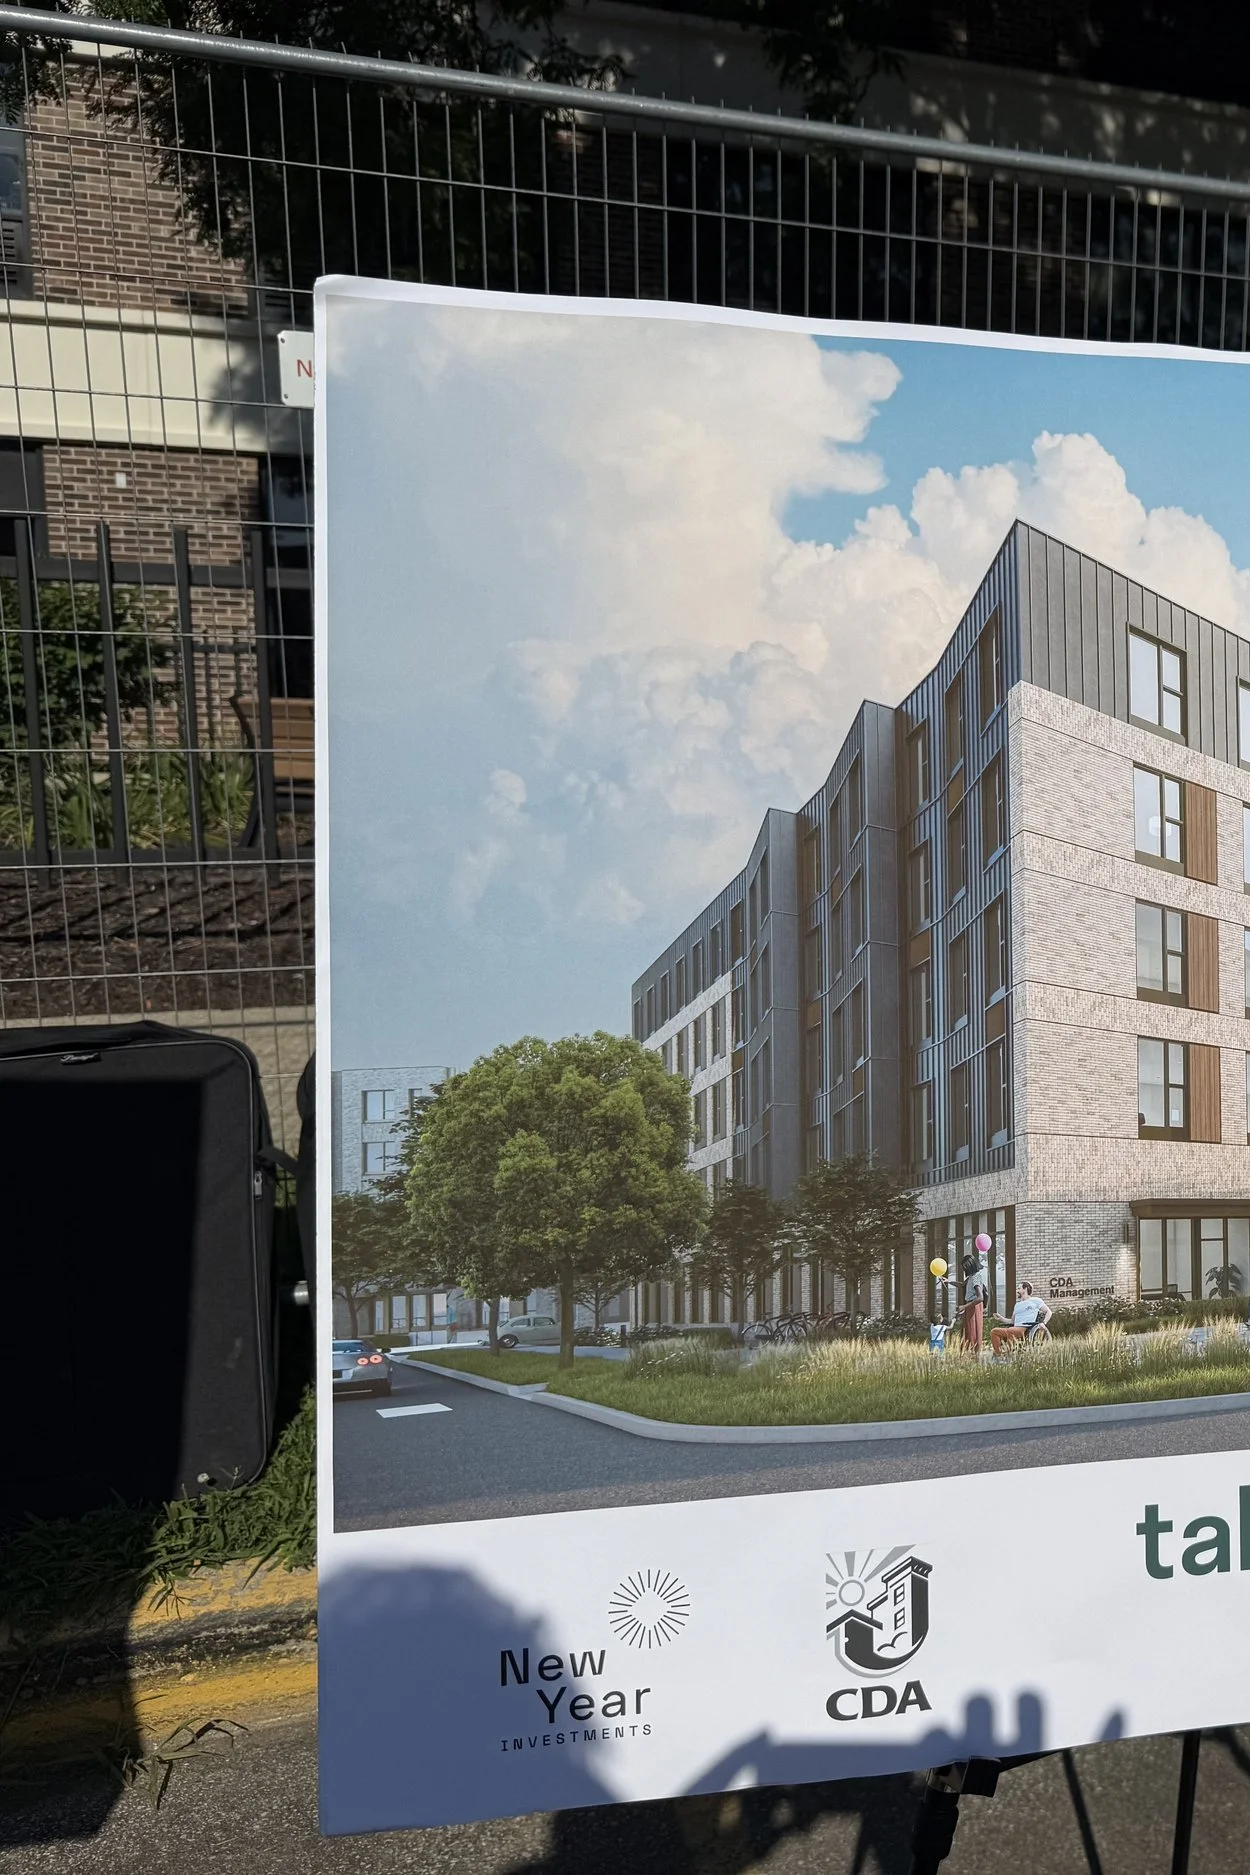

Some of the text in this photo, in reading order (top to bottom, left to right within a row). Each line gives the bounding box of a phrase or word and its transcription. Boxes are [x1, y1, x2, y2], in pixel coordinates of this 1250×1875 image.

[1049, 1277, 1073, 1288] CDA
[1050, 1285, 1115, 1298] Management
[500, 1648, 606, 1686] New
[536, 1686, 651, 1724] Year
[826, 1680, 932, 1721] CDA
[501, 1724, 652, 1751] INVESTMENTS
